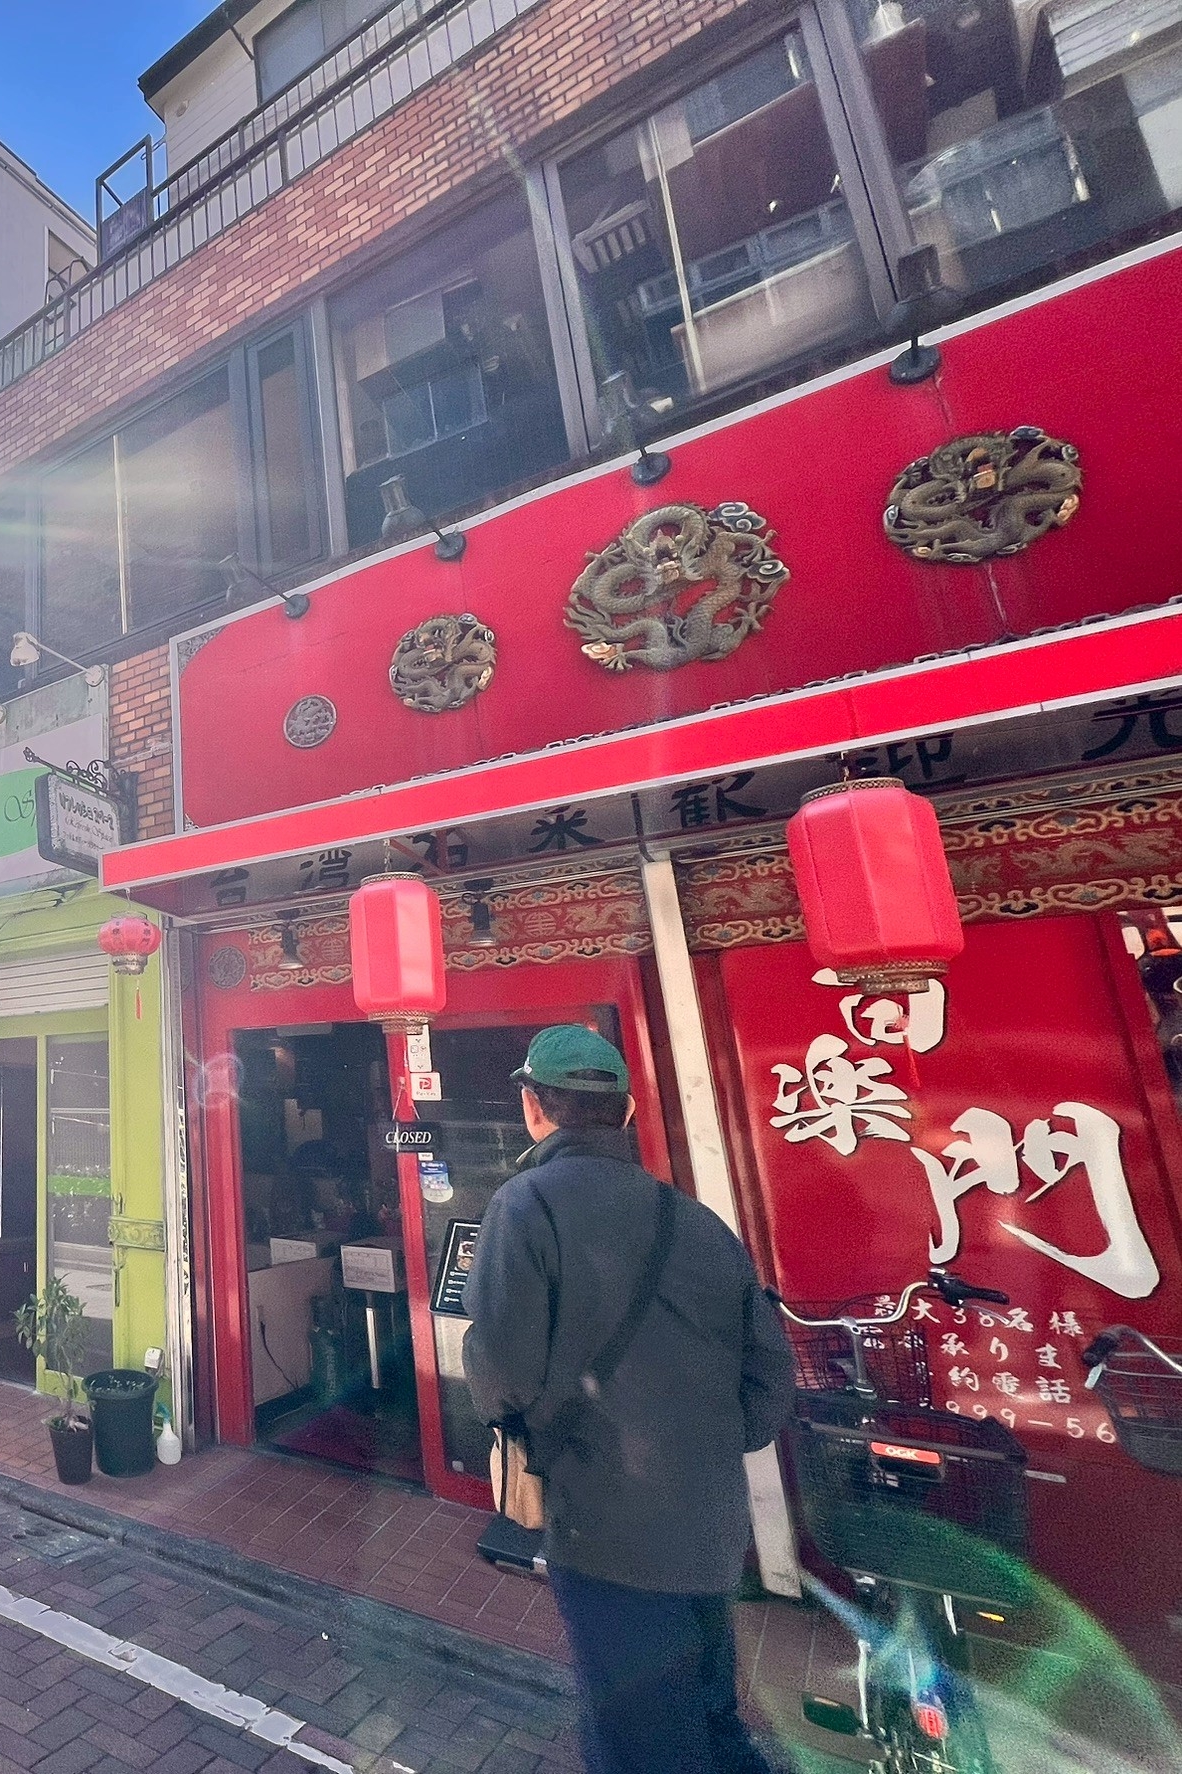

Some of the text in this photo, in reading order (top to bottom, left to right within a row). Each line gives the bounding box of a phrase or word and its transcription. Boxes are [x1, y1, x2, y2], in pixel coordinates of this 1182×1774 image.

[385, 1131, 432, 1144] CLOSED
[912, 1361, 1071, 1404] 約電話
[885, 1447, 920, 1461] OGK
